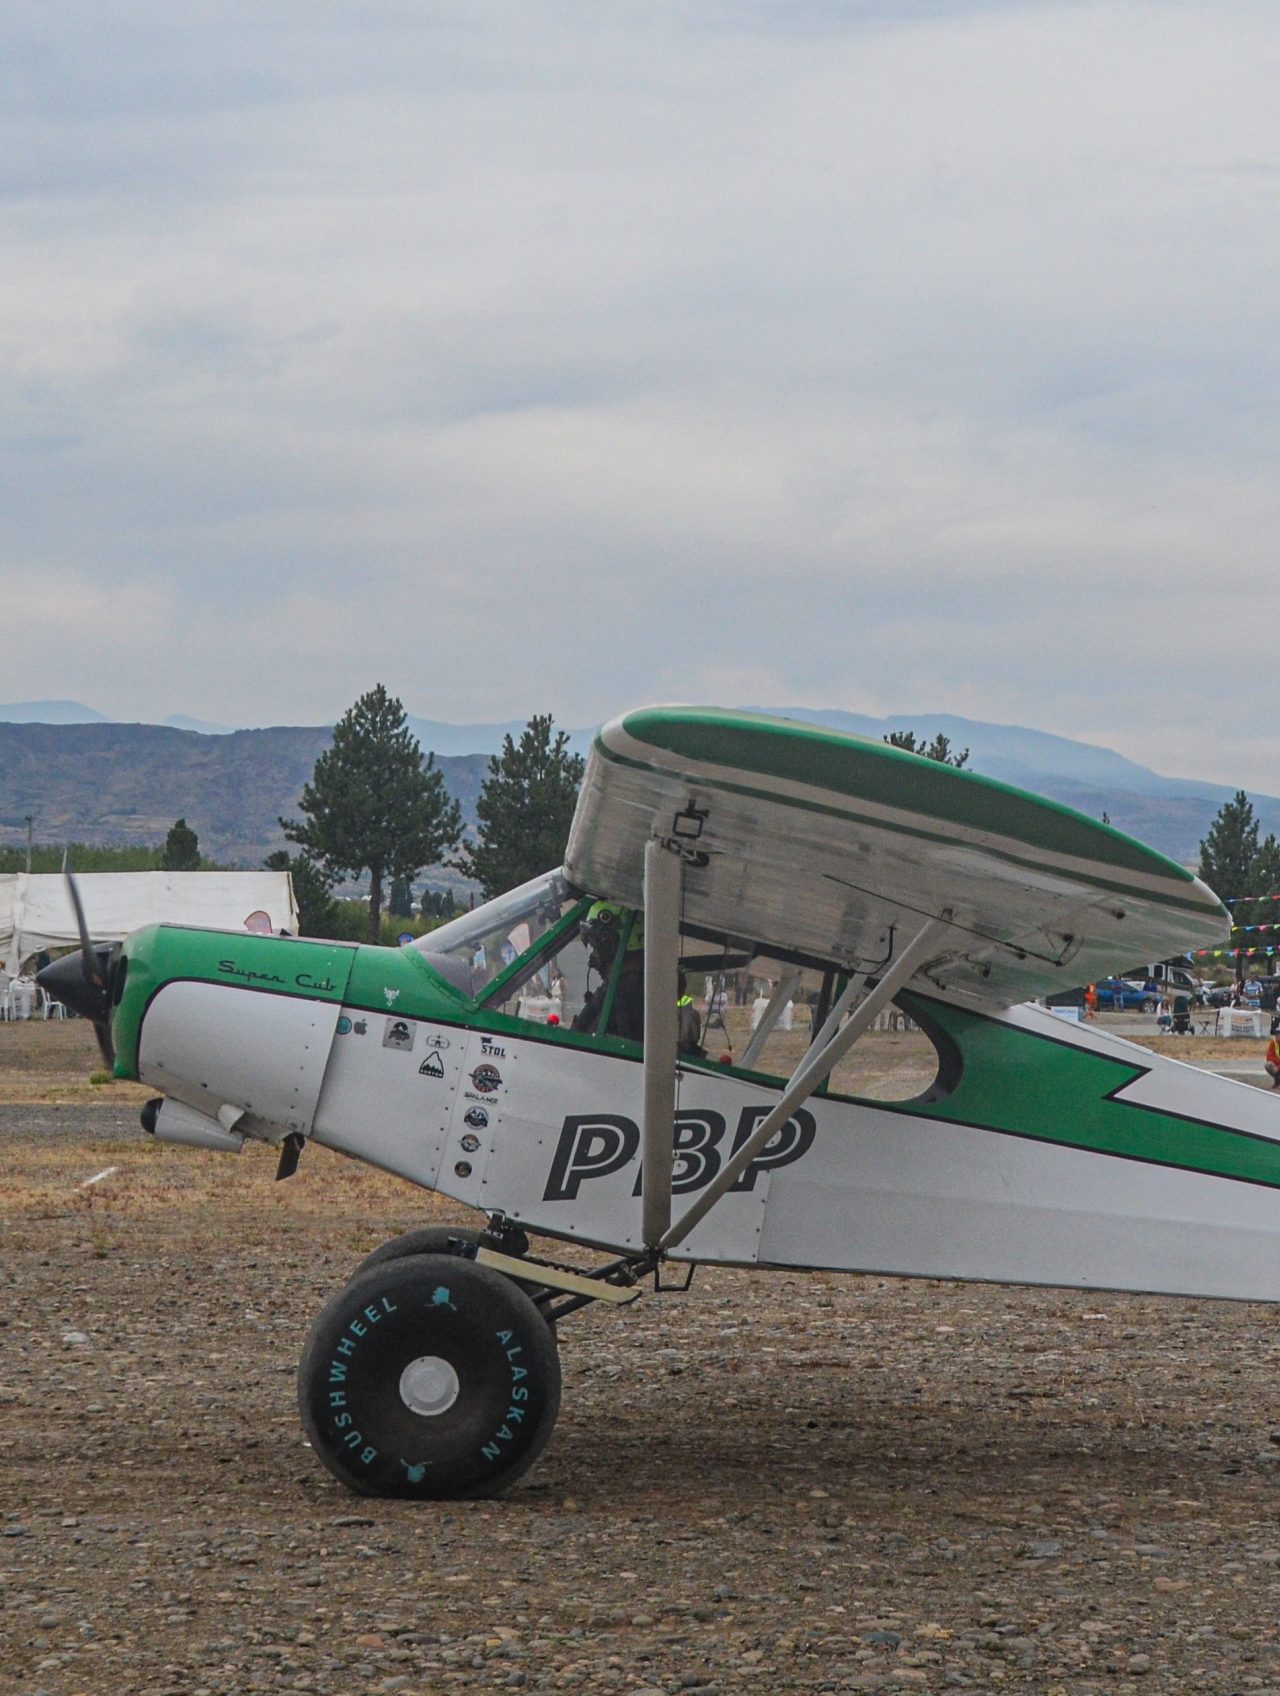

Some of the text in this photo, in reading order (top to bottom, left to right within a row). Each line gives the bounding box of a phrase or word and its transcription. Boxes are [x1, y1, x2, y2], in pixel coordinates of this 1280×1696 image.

[217, 960, 337, 991] Super Cub
[481, 1045, 506, 1057] STOL
[542, 1105, 817, 1202] PBP
[328, 1296, 398, 1464] BUSHWHEEL
[481, 1328, 529, 1461] ALASKAN
